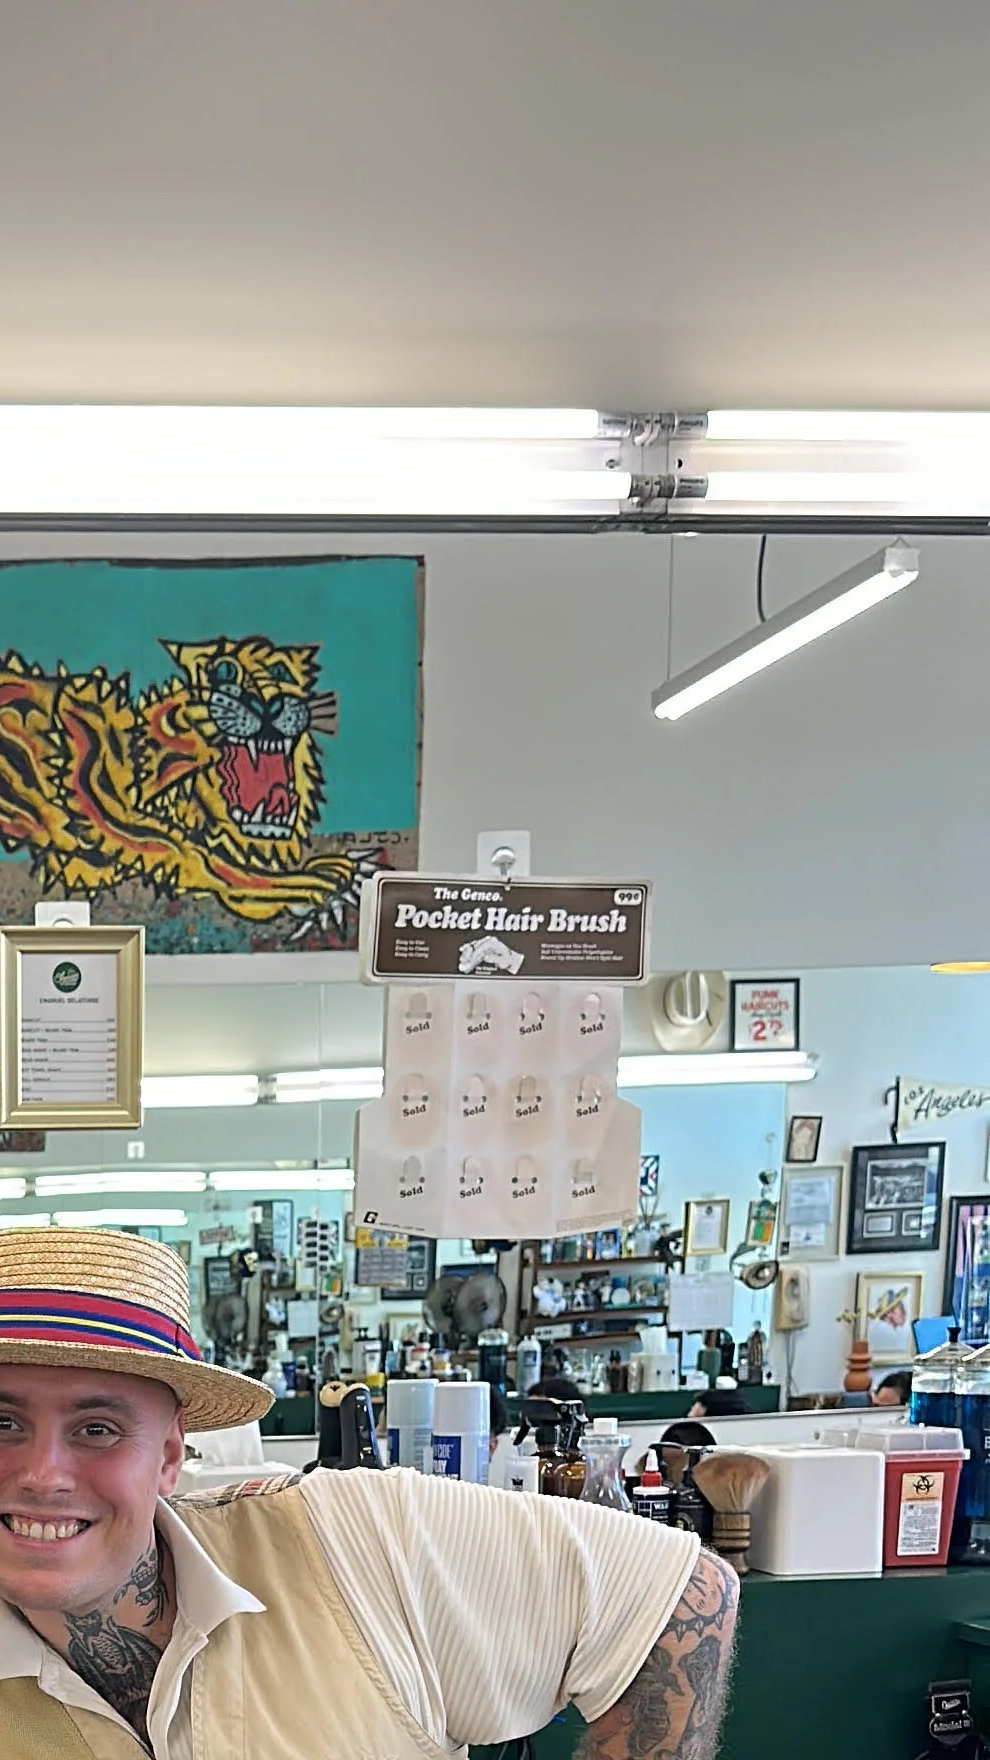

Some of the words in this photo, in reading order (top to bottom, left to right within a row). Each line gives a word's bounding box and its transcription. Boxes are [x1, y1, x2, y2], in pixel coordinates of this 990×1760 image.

[433, 887, 458, 900] The
[461, 888, 503, 902] Genco.
[394, 904, 482, 931] Pocket
[483, 906, 545, 932] Hair
[547, 908, 628, 933] Brush
[405, 1022, 431, 1034] Sold
[466, 1022, 490, 1035] Sold
[519, 1022, 543, 1035] Sold
[580, 1022, 604, 1035] Sold
[402, 1104, 427, 1117] Sold
[462, 1104, 486, 1117] Sold
[914, 1088, 986, 1120] Angeles
[515, 1104, 540, 1118] Sold
[576, 1105, 599, 1117] Sold
[399, 1186, 423, 1198] Sold
[459, 1186, 483, 1198] Sold
[512, 1186, 536, 1198] Sold
[571, 1186, 596, 1198] Sold
